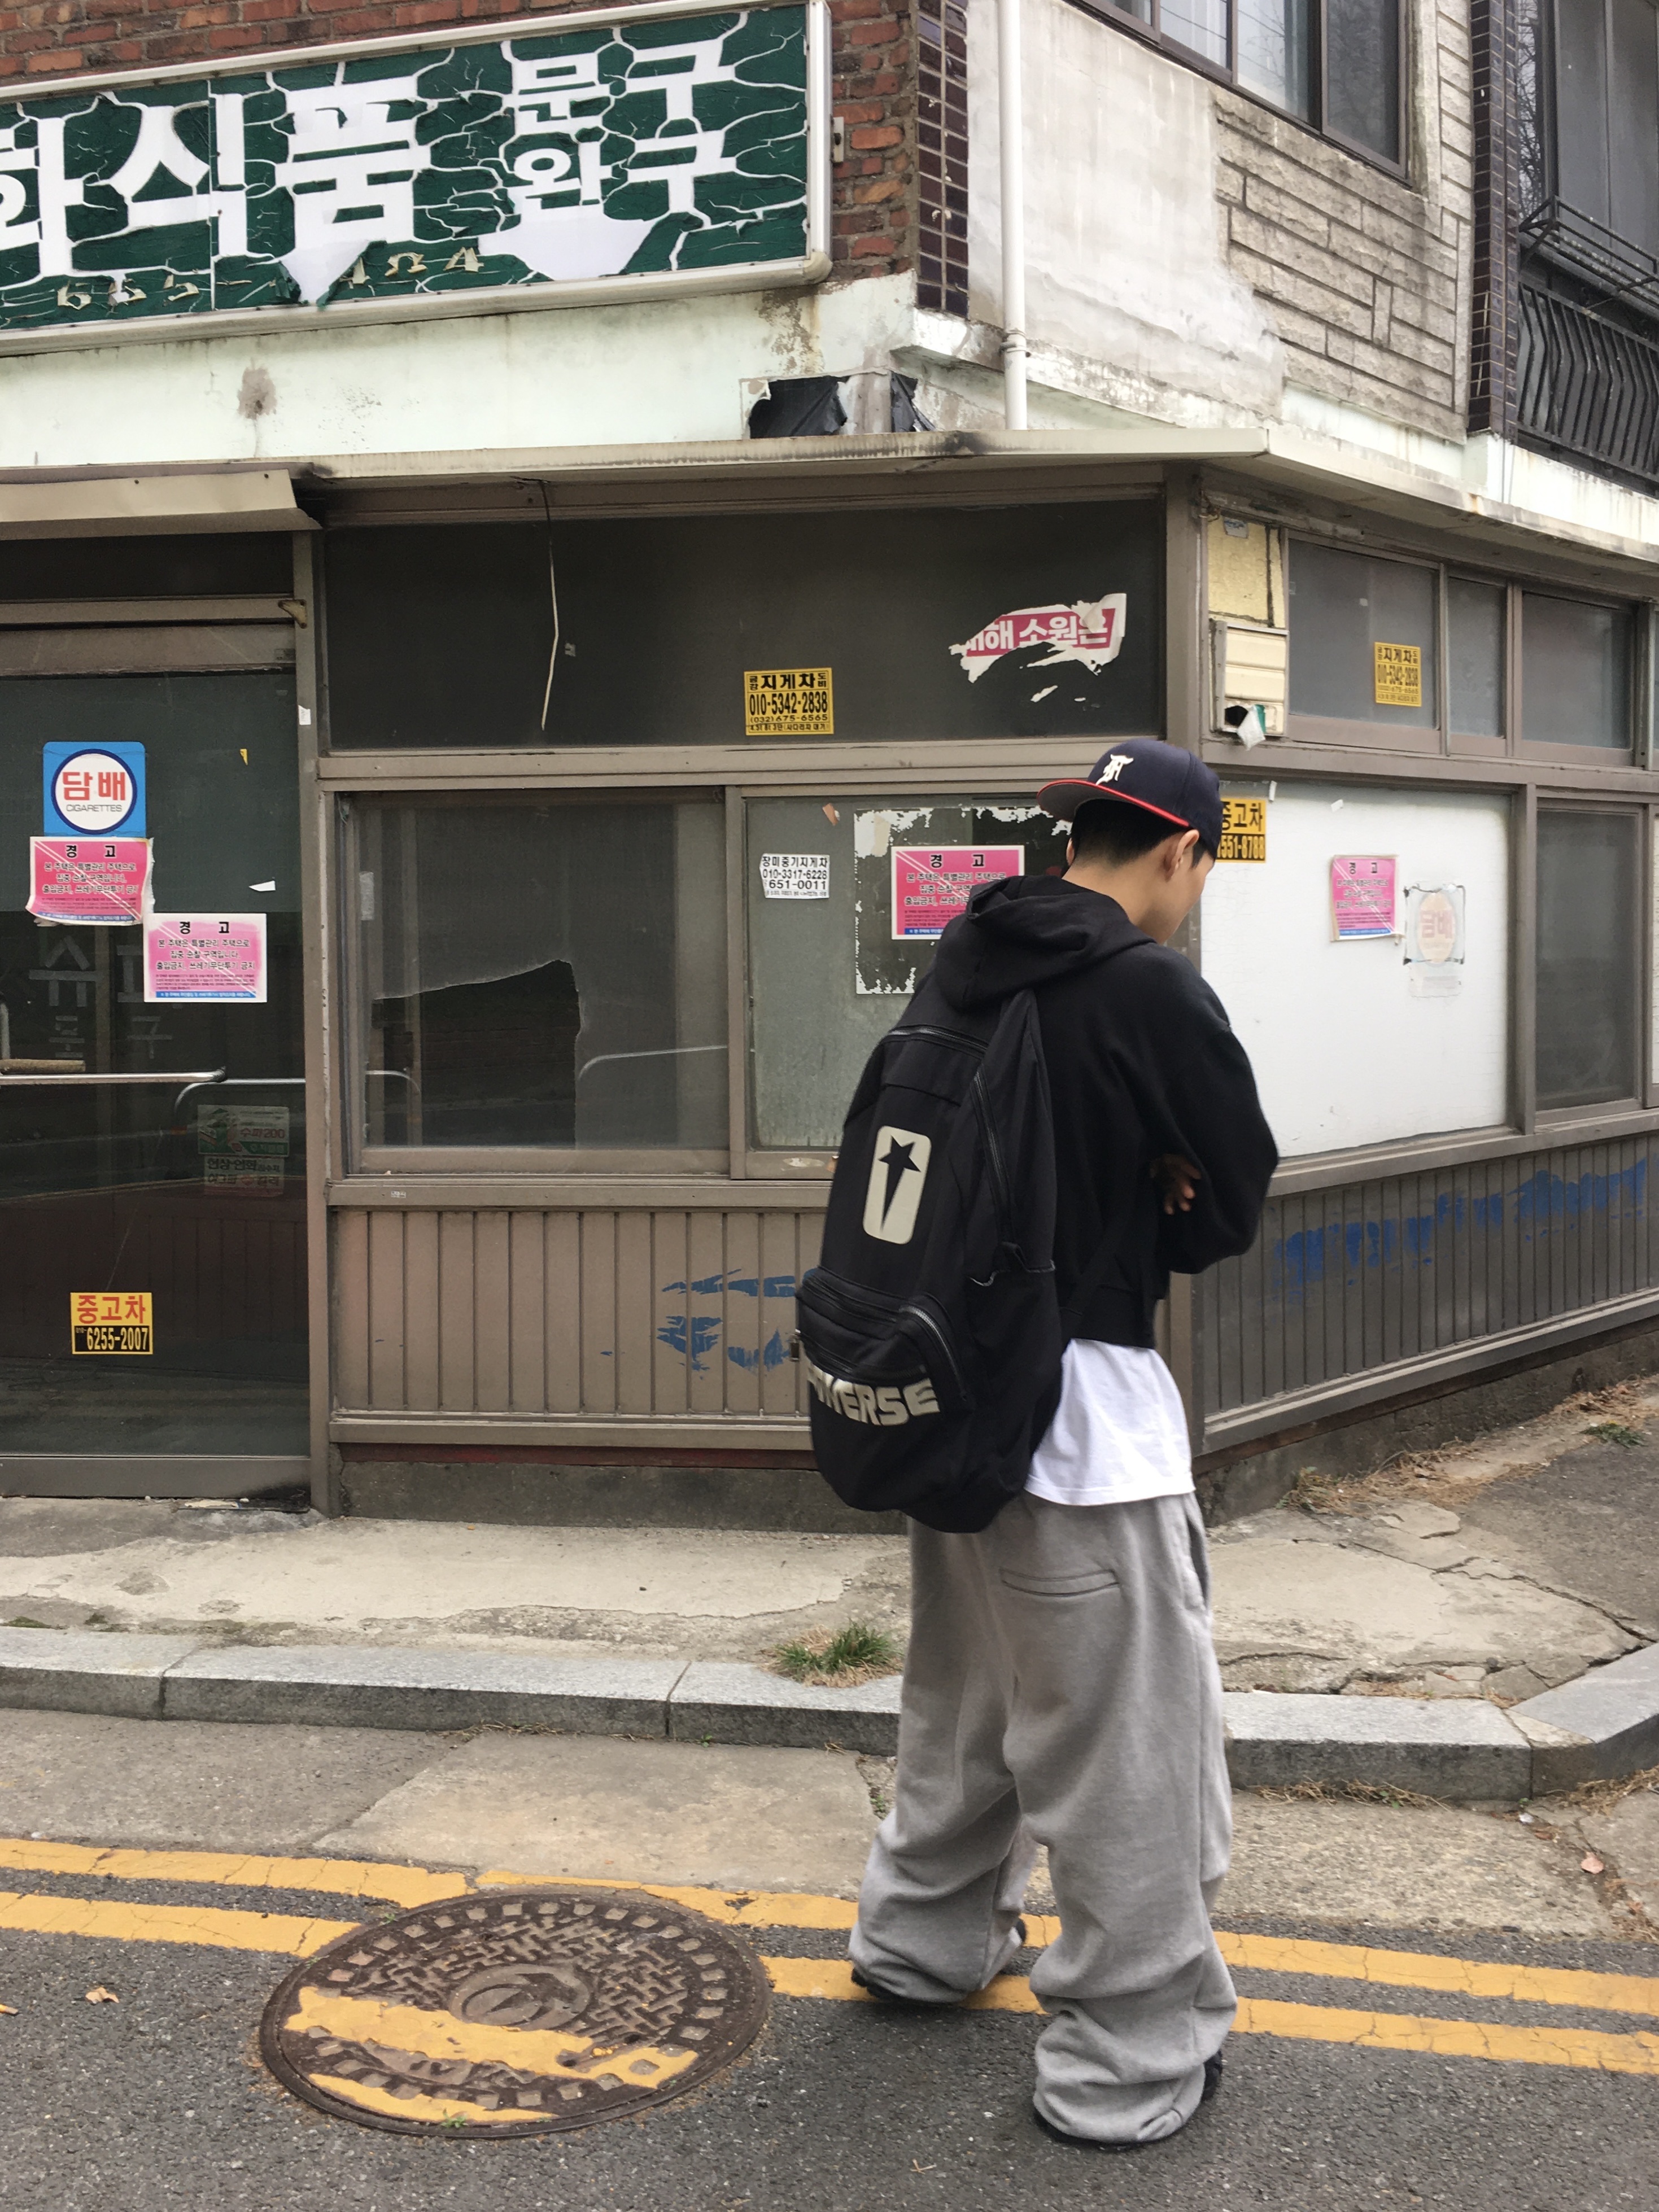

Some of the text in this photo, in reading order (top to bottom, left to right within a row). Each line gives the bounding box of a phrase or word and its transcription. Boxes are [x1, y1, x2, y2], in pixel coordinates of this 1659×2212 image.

[761, 673, 815, 690] 지게차
[62, 771, 126, 801] 담배
[66, 804, 123, 812] CIGARETTES
[762, 856, 828, 868] 장미중기지게차
[769, 879, 826, 890] 651-0011
[77, 1295, 146, 1324] 중고차
